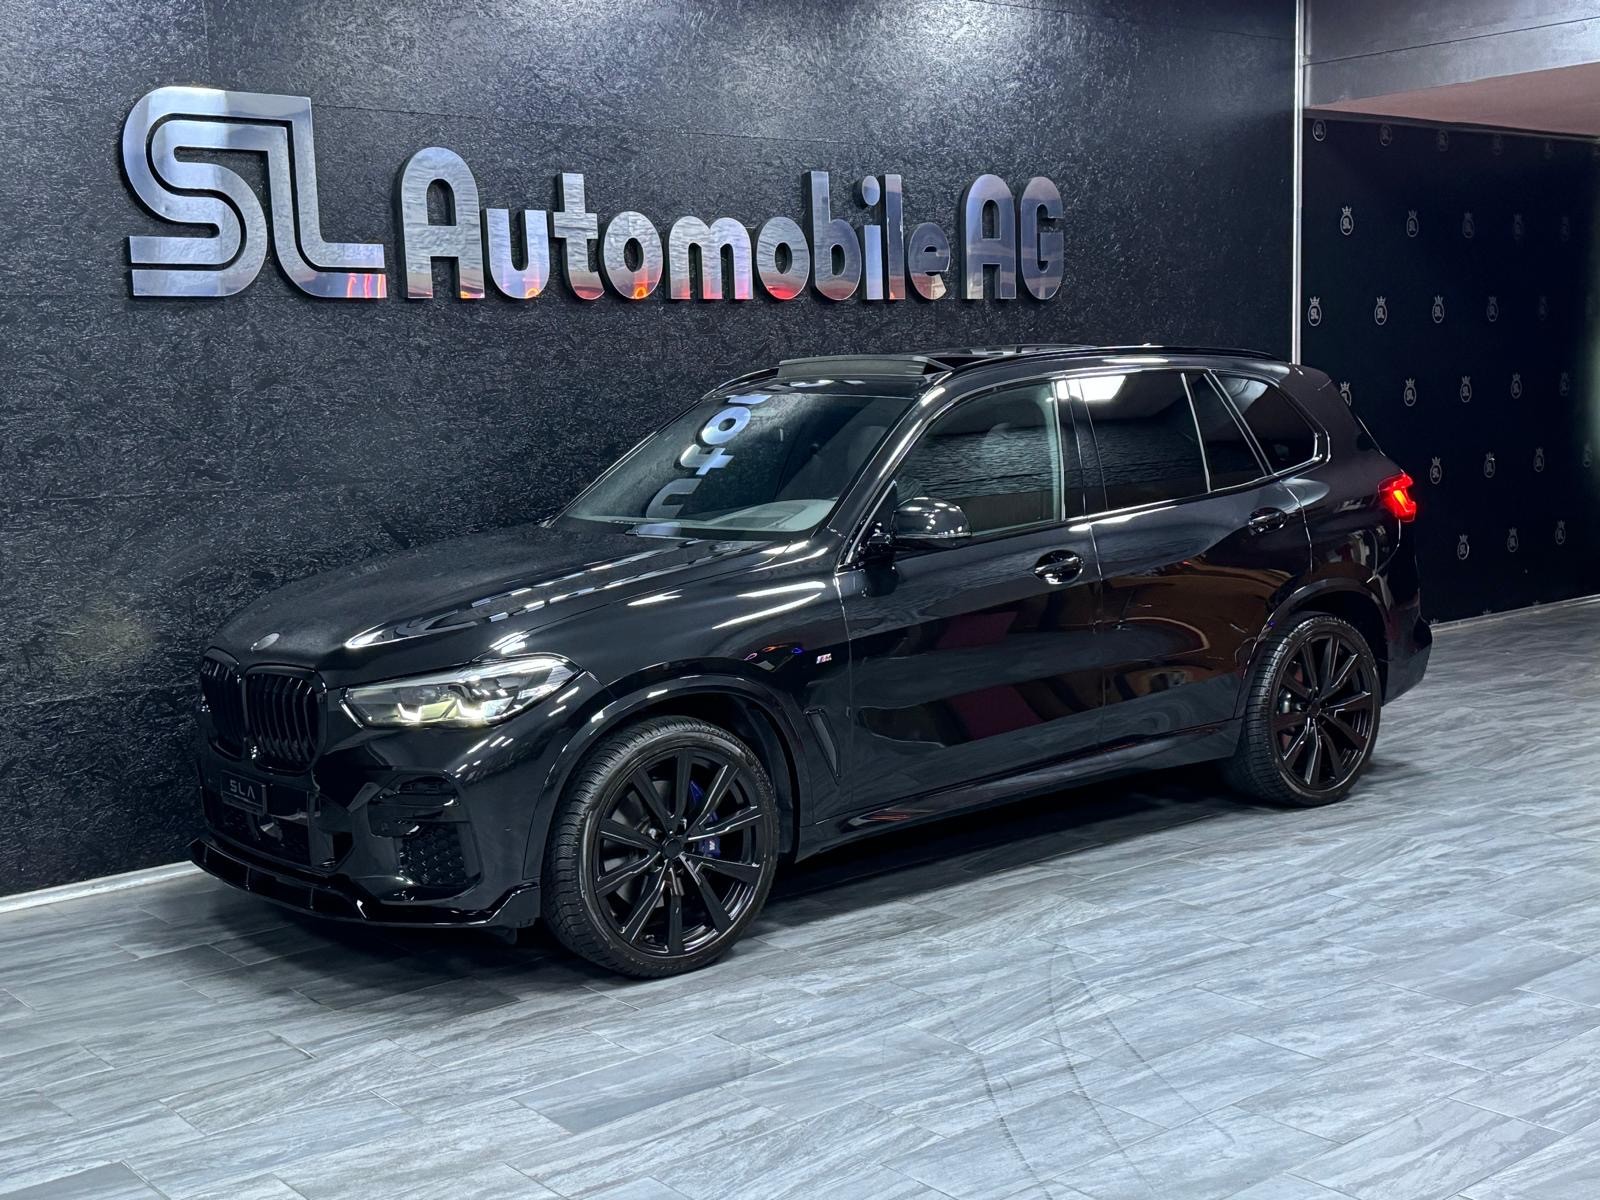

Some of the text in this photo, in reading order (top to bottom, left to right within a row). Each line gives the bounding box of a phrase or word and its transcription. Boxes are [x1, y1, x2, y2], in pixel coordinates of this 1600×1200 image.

[121, 86, 1065, 301] SL Automobile AG
